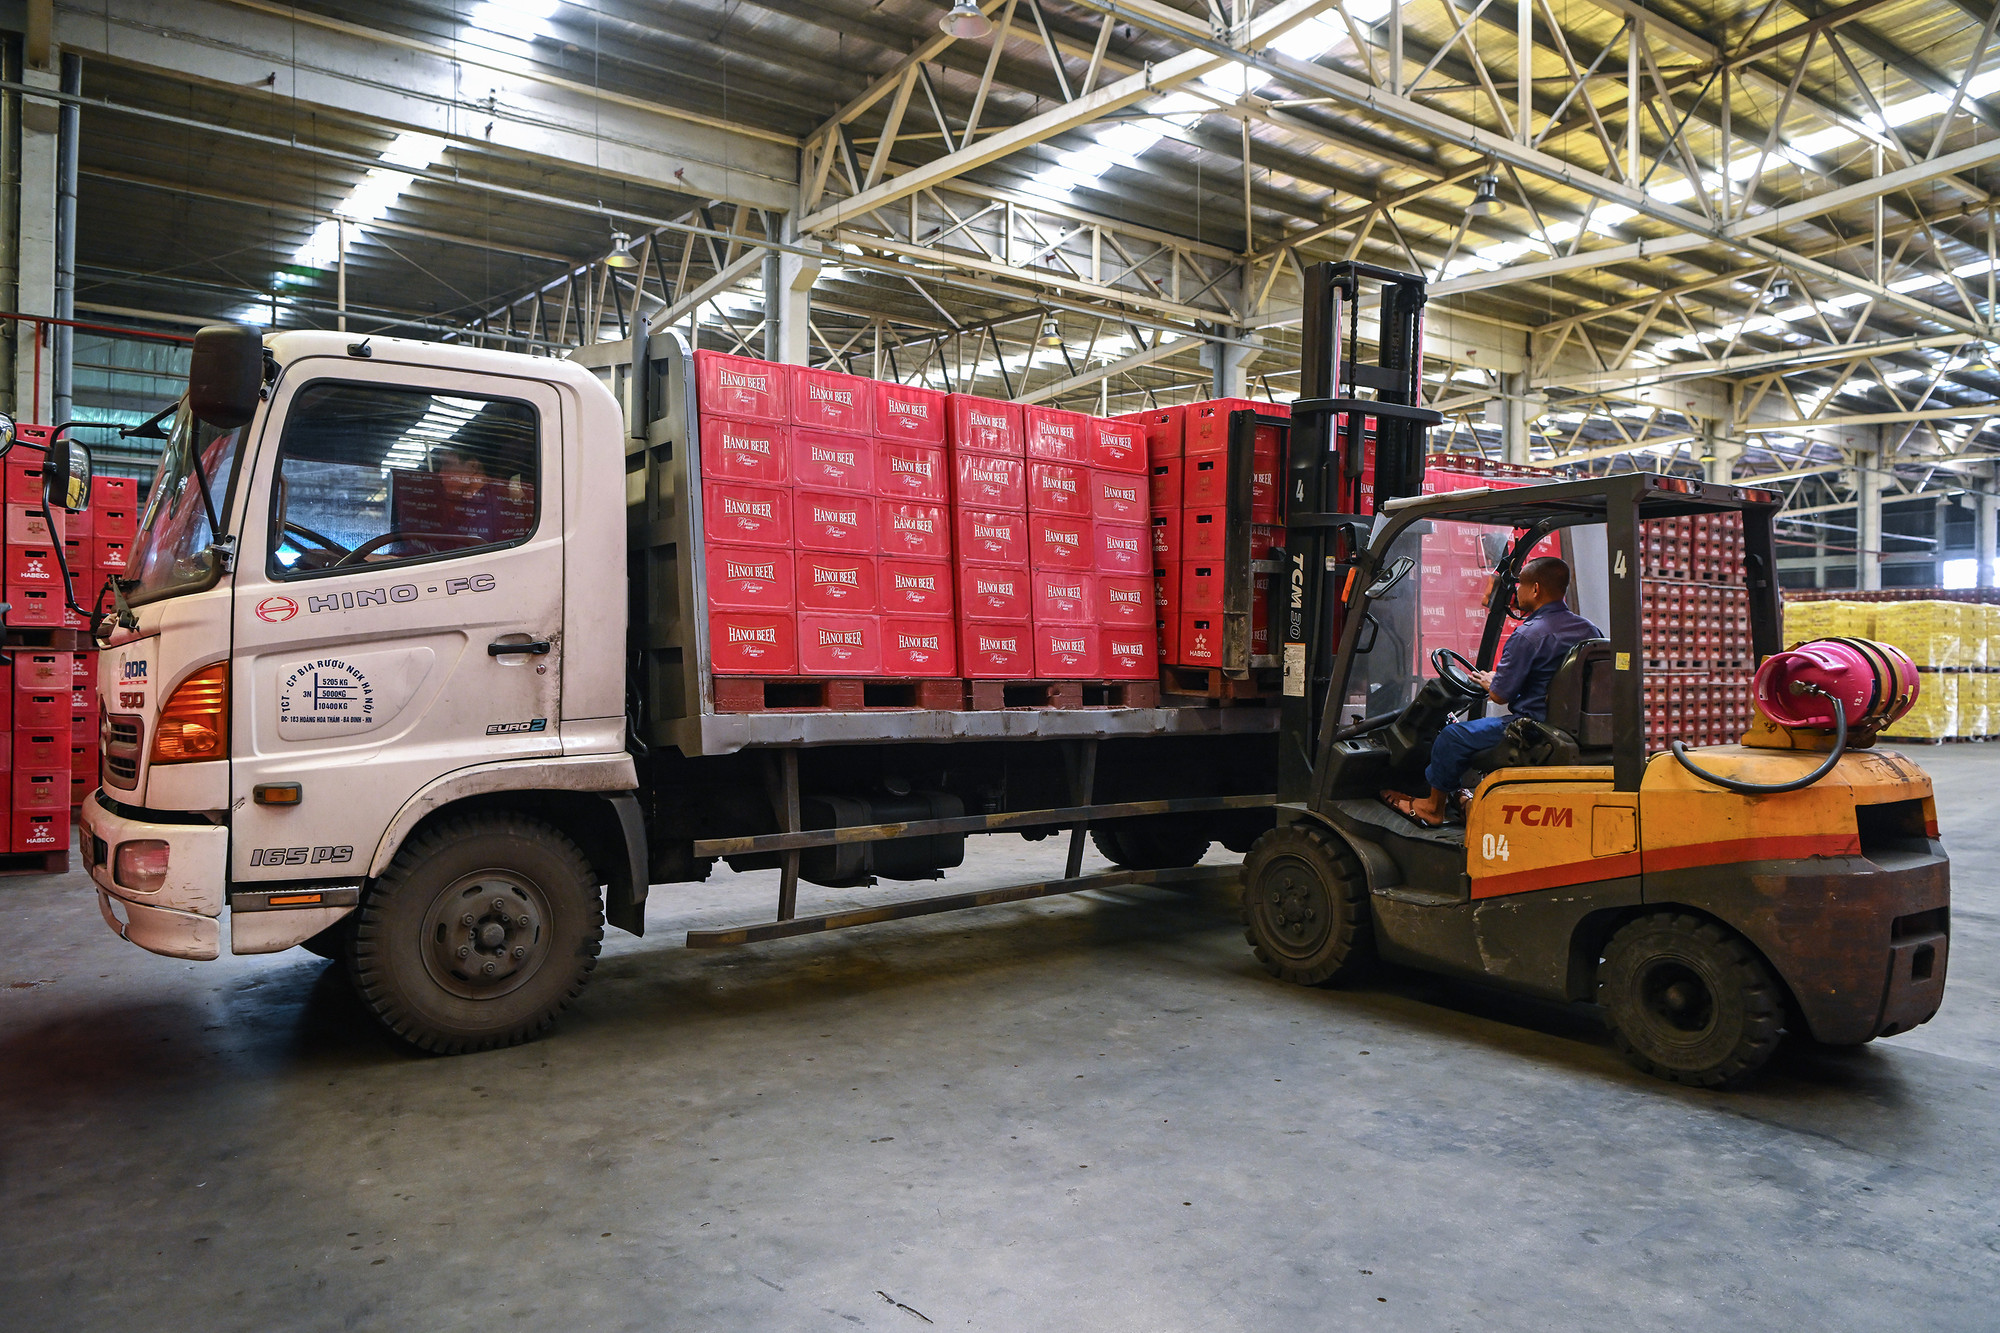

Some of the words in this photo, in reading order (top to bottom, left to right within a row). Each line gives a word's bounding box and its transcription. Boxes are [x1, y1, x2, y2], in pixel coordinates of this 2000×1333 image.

[720, 370, 746, 388] HANOI
[747, 375, 766, 393] BEER
[809, 386, 833, 402] HANOI
[835, 389, 852, 406] BEER
[888, 400, 910, 415] HANOI
[911, 402, 928, 418] BEER
[970, 413, 990, 428] HANOI
[992, 416, 1007, 431] BEER
[1041, 422, 1059, 436] HANOI
[1060, 425, 1074, 439] BEER
[723, 434, 749, 451] HANOI
[750, 439, 770, 454] BEER
[1101, 433, 1117, 447] HANOI
[1119, 436, 1132, 449] BEER
[812, 447, 836, 464] HANOI
[837, 450, 855, 466] BEER
[891, 458, 913, 473] HANOI
[915, 462, 931, 477] BEER
[973, 470, 992, 483] HANOI
[994, 473, 1009, 485] BEER
[1043, 476, 1061, 490] HANOI
[1062, 480, 1076, 493] BEER
[1104, 486, 1121, 499] HANOI
[1123, 489, 1136, 501] BEER
[1296, 479, 1304, 502] 4
[724, 498, 751, 515] HANOI
[753, 502, 772, 518] BEER
[814, 508, 837, 523] HANOI
[839, 512, 857, 526] BEER
[894, 517, 916, 531] HANOI
[917, 519, 933, 534] BEER
[974, 525, 994, 538] HANOI
[996, 527, 1011, 540] BEER
[1045, 530, 1063, 544] HANOI
[1065, 533, 1079, 546] BEER
[1107, 537, 1124, 550] HANOI
[1125, 539, 1138, 551] BEER
[727, 563, 754, 578] HANOI
[755, 565, 774, 580] BEER
[1614, 549, 1627, 579] 4
[814, 569, 837, 583] HANOI
[839, 571, 857, 585] BEER
[895, 575, 917, 589] HANOI
[919, 577, 935, 591] BEER
[1291, 553, 1304, 609] TCM
[308, 583, 418, 613] HINO
[446, 574, 495, 595] FC
[977, 581, 997, 594] HANOI
[999, 582, 1013, 595] BEER
[1048, 586, 1066, 599] HANOI
[1067, 587, 1081, 600] BEER
[1110, 590, 1127, 602] HANOI
[1128, 591, 1141, 604] BEER
[729, 627, 755, 642] HANOI
[756, 628, 776, 643] BEER
[819, 631, 843, 645] HANOI
[845, 632, 863, 646] BEER
[899, 635, 920, 649] HANOI
[922, 636, 938, 650] BEER
[980, 638, 1000, 650] HANOI
[1002, 639, 1016, 652] BEER
[1052, 639, 1070, 651] HANOI
[1072, 640, 1085, 653] BEER
[1113, 643, 1129, 655] HANOI
[1131, 644, 1143, 657] BEER
[125, 660, 147, 679] QDR
[281, 696, 290, 712] TCT
[286, 674, 298, 687] CP
[297, 663, 315, 676] BIA
[346, 665, 366, 682] NGK
[120, 692, 145, 709] 500
[1502, 804, 1573, 828] TCM
[1482, 833, 1509, 861] 04
[250, 847, 309, 867] 165
[311, 845, 353, 863] PS
